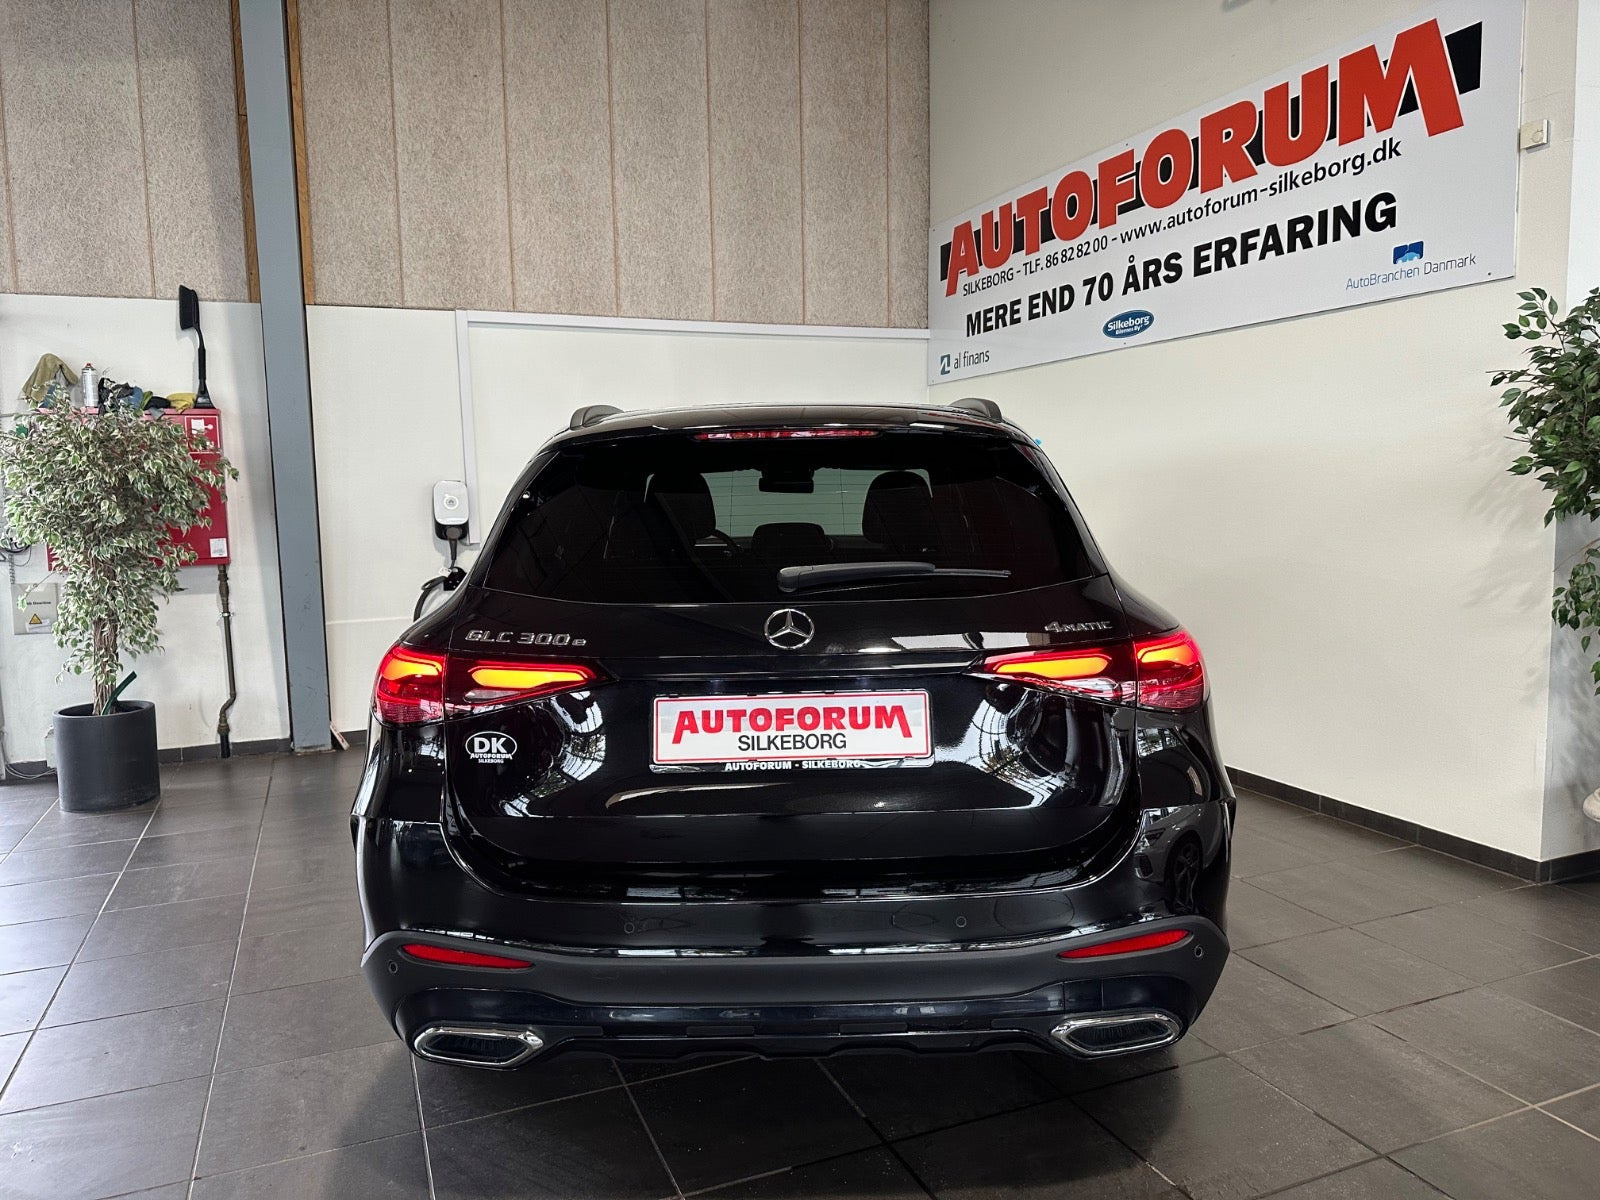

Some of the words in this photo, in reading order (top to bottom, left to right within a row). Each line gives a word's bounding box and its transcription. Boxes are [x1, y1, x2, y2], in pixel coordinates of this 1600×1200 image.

[945, 18, 1464, 297] AUTOFORUM
[963, 268, 1014, 297] SILKEBORG
[1023, 258, 1044, 276] TLF.
[1045, 252, 1059, 269] 86
[1060, 247, 1075, 264] 82
[1076, 241, 1091, 259] 82
[1092, 235, 1108, 253] 00
[1120, 137, 1402, 244] www.autoforum-silkeborg.dk
[966, 298, 1022, 338] MERE
[1028, 284, 1075, 321] END
[1082, 272, 1114, 306] 70
[1122, 252, 1183, 296] ÅRS
[1193, 191, 1397, 277] ERFARING
[1346, 266, 1420, 290] AutoBranchen
[1424, 253, 1477, 275] Danmark
[1107, 316, 1151, 332] Silkeborg
[953, 352, 961, 370] al
[963, 350, 990, 367] finans
[465, 629, 514, 643] GLC
[1044, 621, 1113, 633] 4MATIC
[672, 705, 913, 744] AUTOFORUM
[474, 737, 508, 753] DK
[737, 733, 847, 751] SILKEBORG
[724, 761, 792, 771] AUTOFORUM
[802, 759, 860, 769] SILKEBORG
